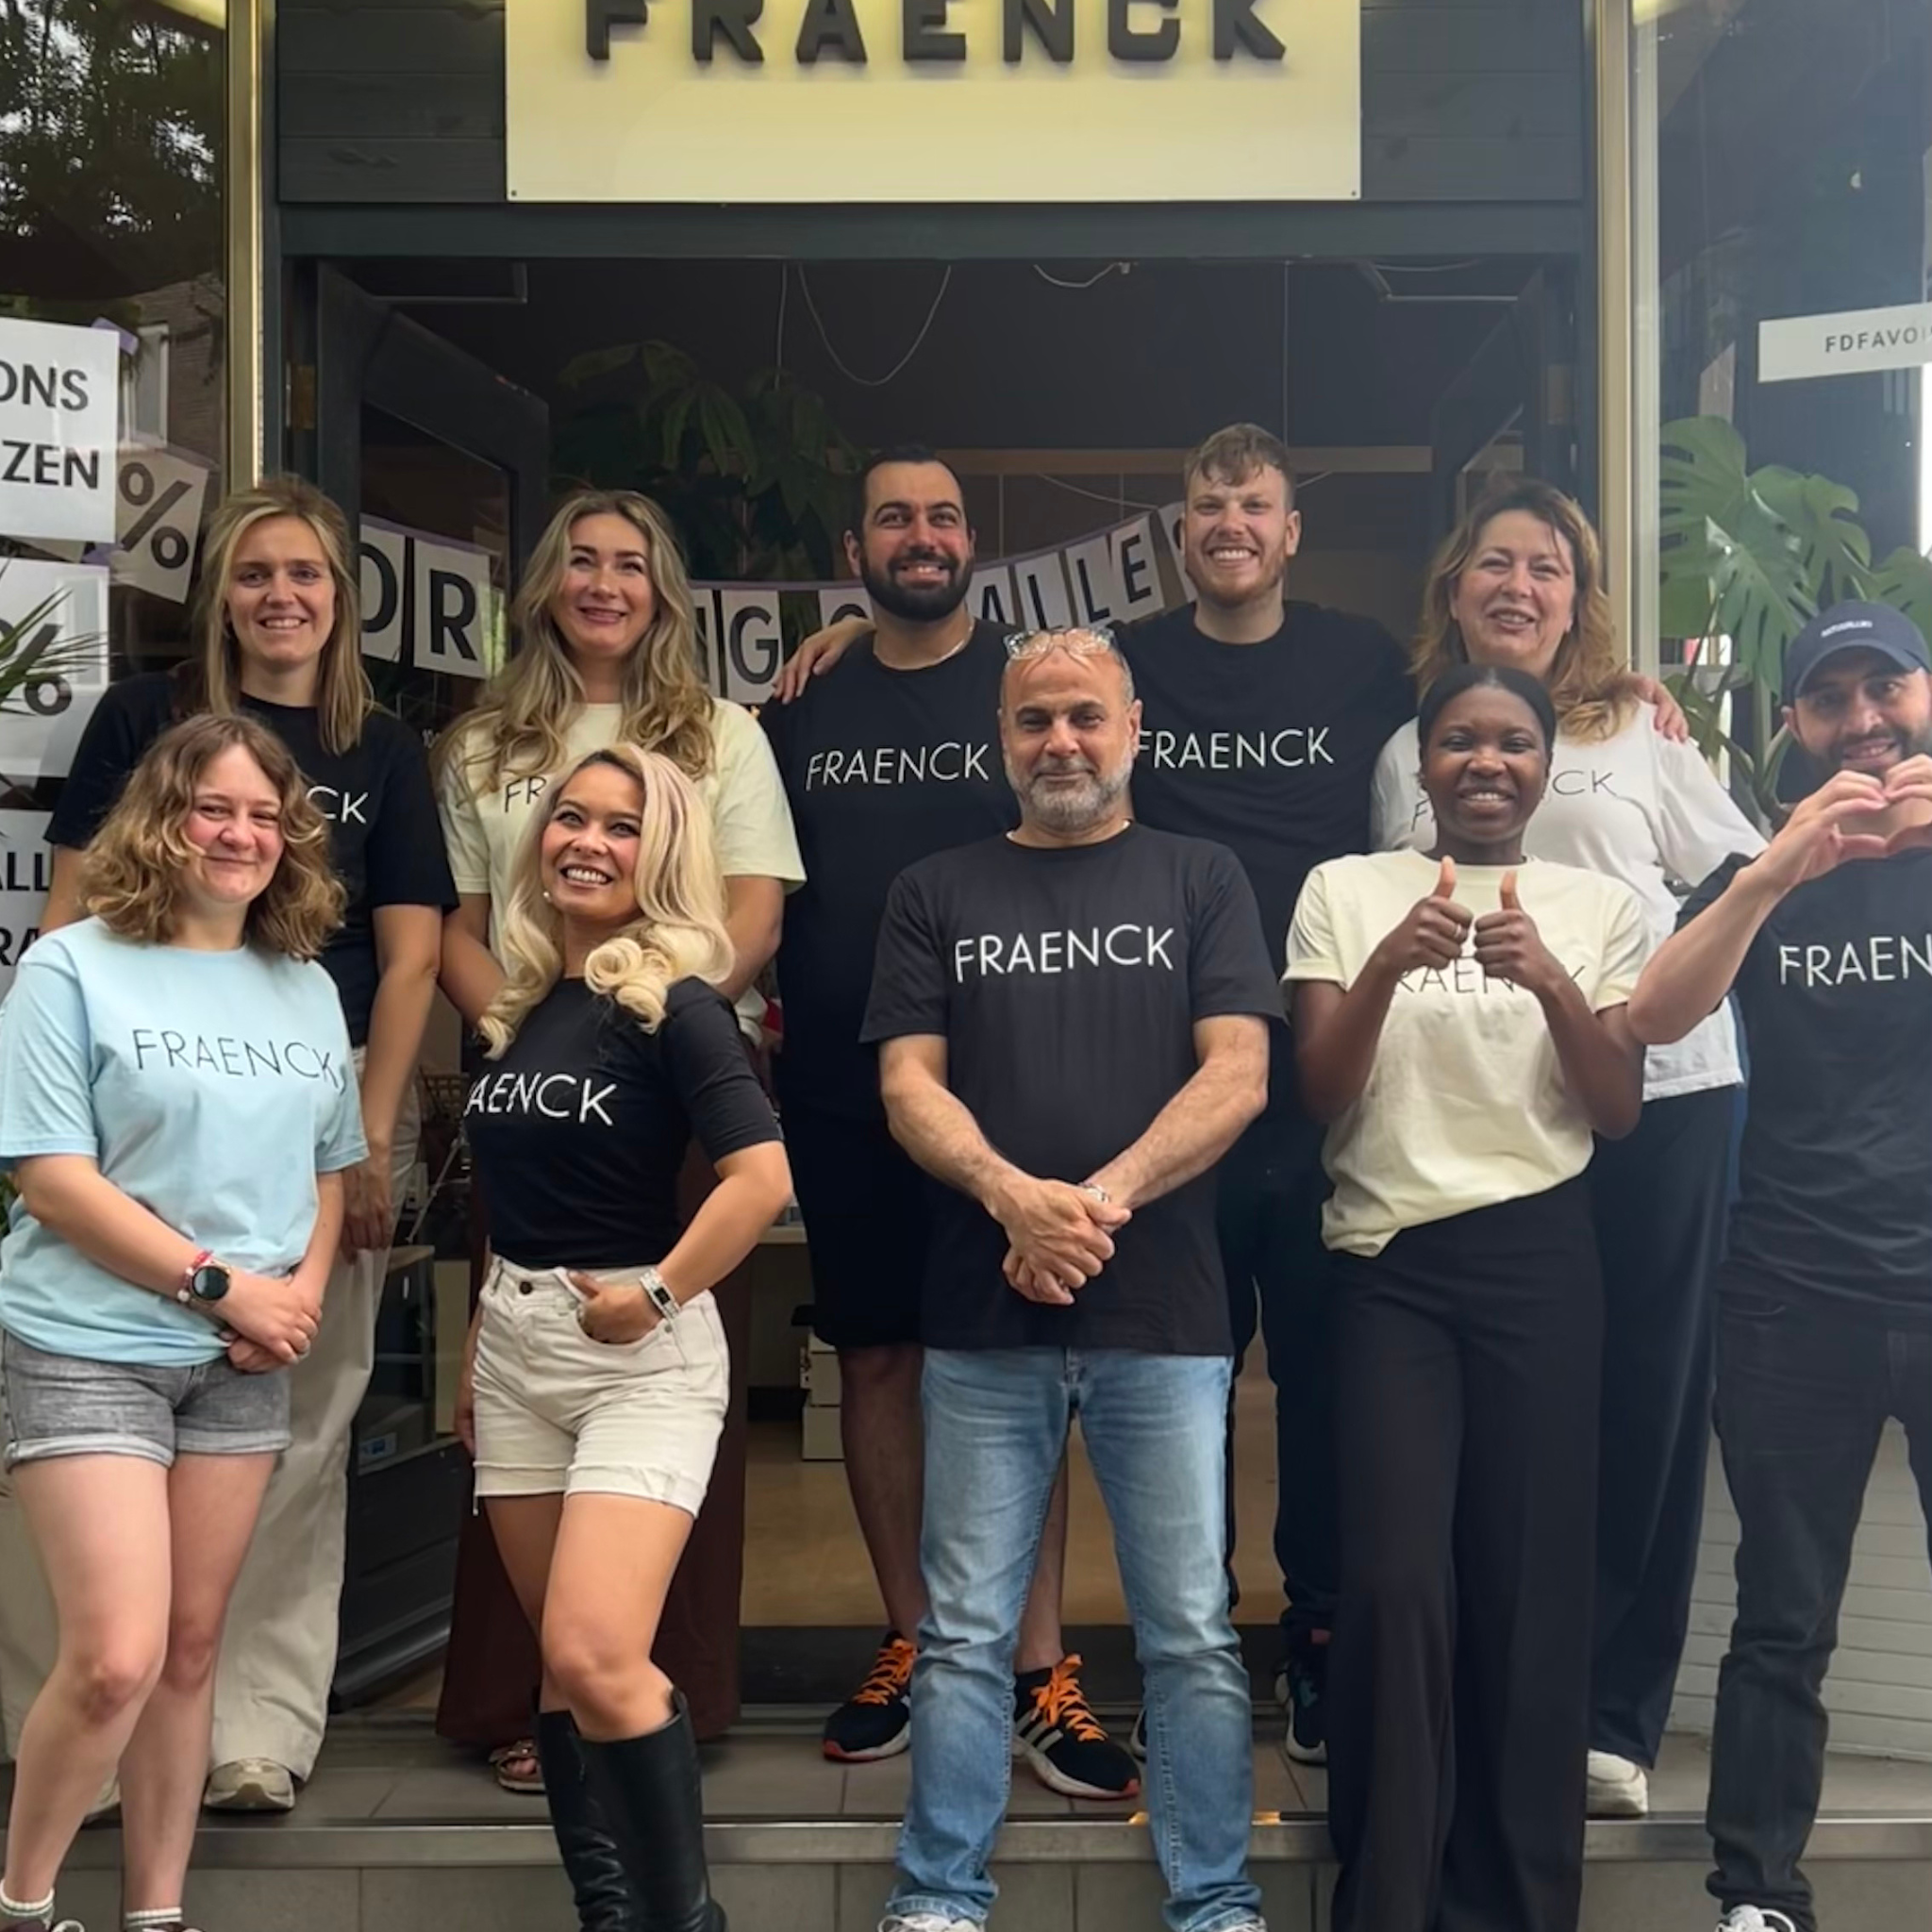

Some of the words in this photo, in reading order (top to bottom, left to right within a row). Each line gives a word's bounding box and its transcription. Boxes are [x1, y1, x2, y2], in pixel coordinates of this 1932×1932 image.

[586, 0, 1287, 62] FRAENCK
[806, 741, 991, 792] FRAENCK
[955, 924, 1174, 983] FRAENCK
[132, 1028, 341, 1090] FRAENCK
